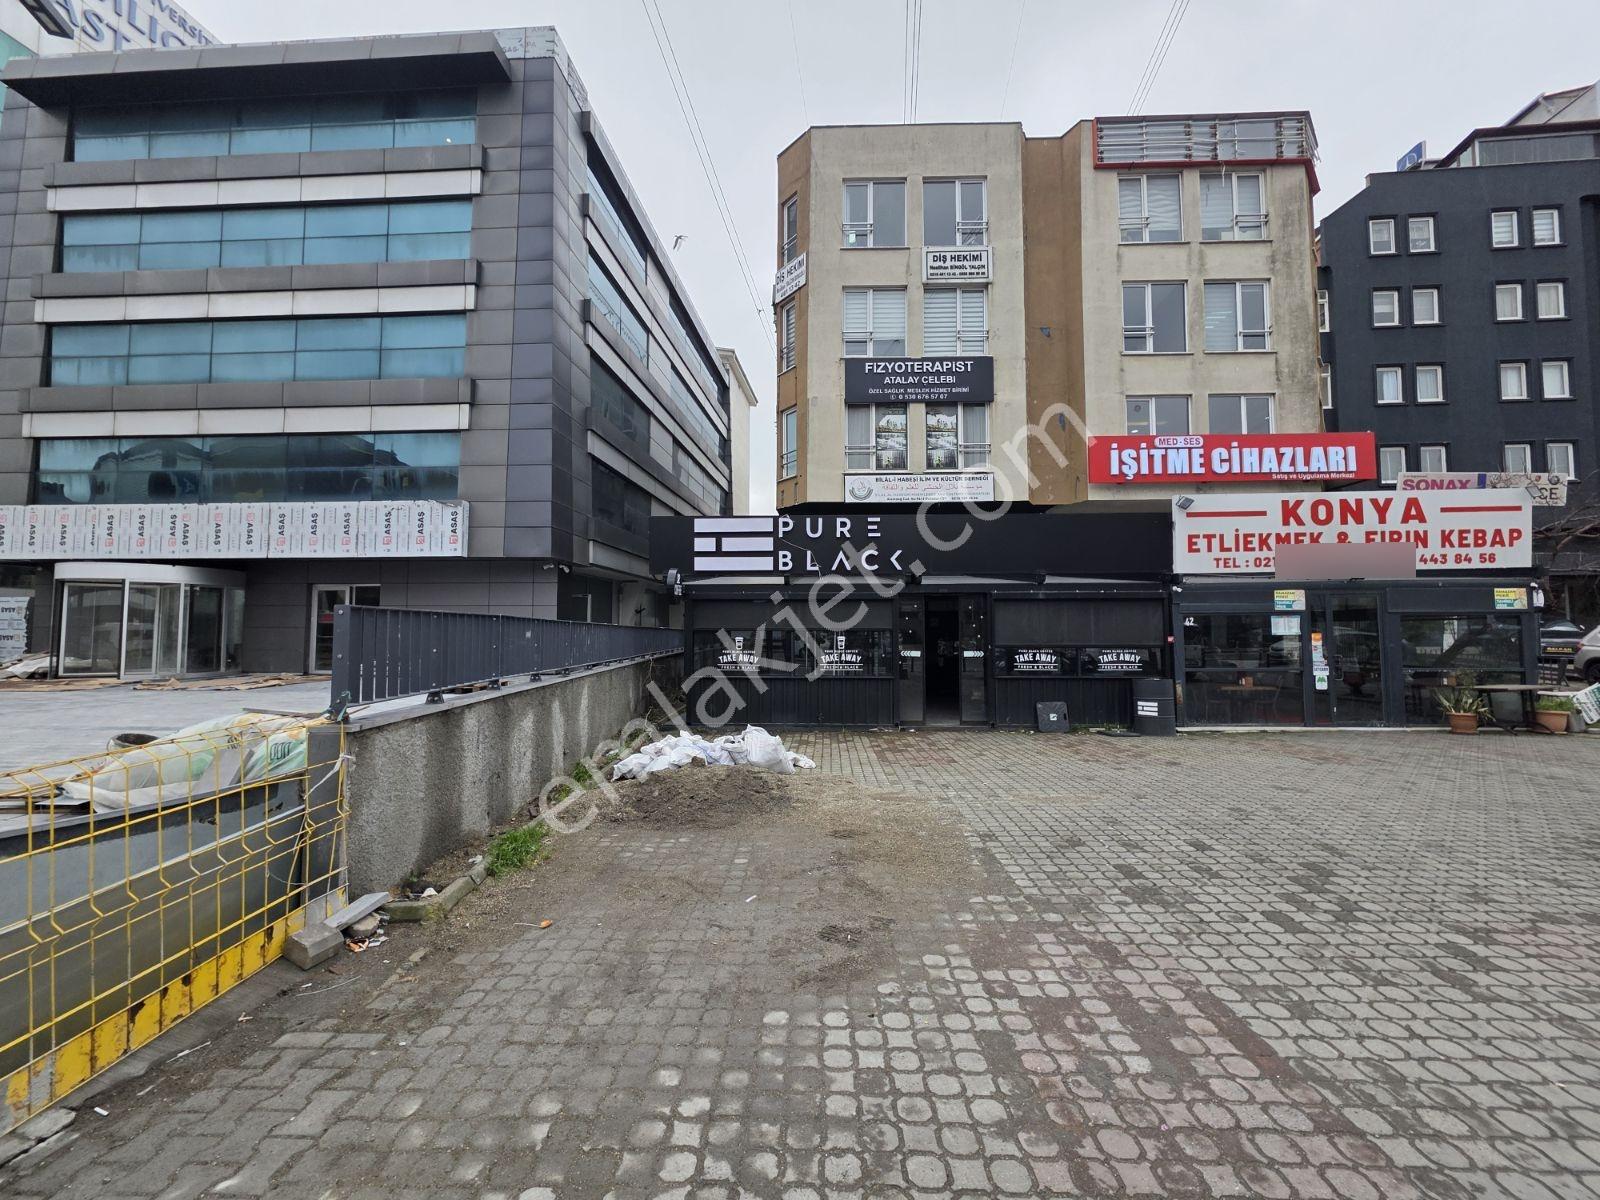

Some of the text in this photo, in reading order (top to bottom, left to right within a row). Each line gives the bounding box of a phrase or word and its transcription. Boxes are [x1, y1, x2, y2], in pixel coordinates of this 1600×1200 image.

[932, 252, 982, 264] DİŞ HEKİMİ
[884, 376, 956, 385] ATALAY ÇELEBİ
[1158, 438, 1178, 446] MED
[1183, 437, 1201, 445] SES
[1110, 442, 1358, 480] İŞİTME CİHAZLARI
[1280, 497, 1428, 526] KONYA
[778, 517, 881, 538] PURE
[1186, 528, 1322, 553] ETLİEKMEK
[1336, 532, 1352, 543] &
[1440, 528, 1523, 549] KEBAP
[778, 550, 902, 571] BLACK
[1214, 558, 1241, 568] TEL
[1419, 554, 1448, 564] 443
[1454, 554, 1473, 564] 84
[1479, 553, 1496, 563] 56
[1184, 617, 1196, 626] 42
[718, 654, 759, 664] TAKE AWAY
[820, 654, 861, 664] TAKE AWAY
[1014, 652, 1056, 663] TAKE AWAY
[1098, 652, 1140, 663] TAKE AWAY
